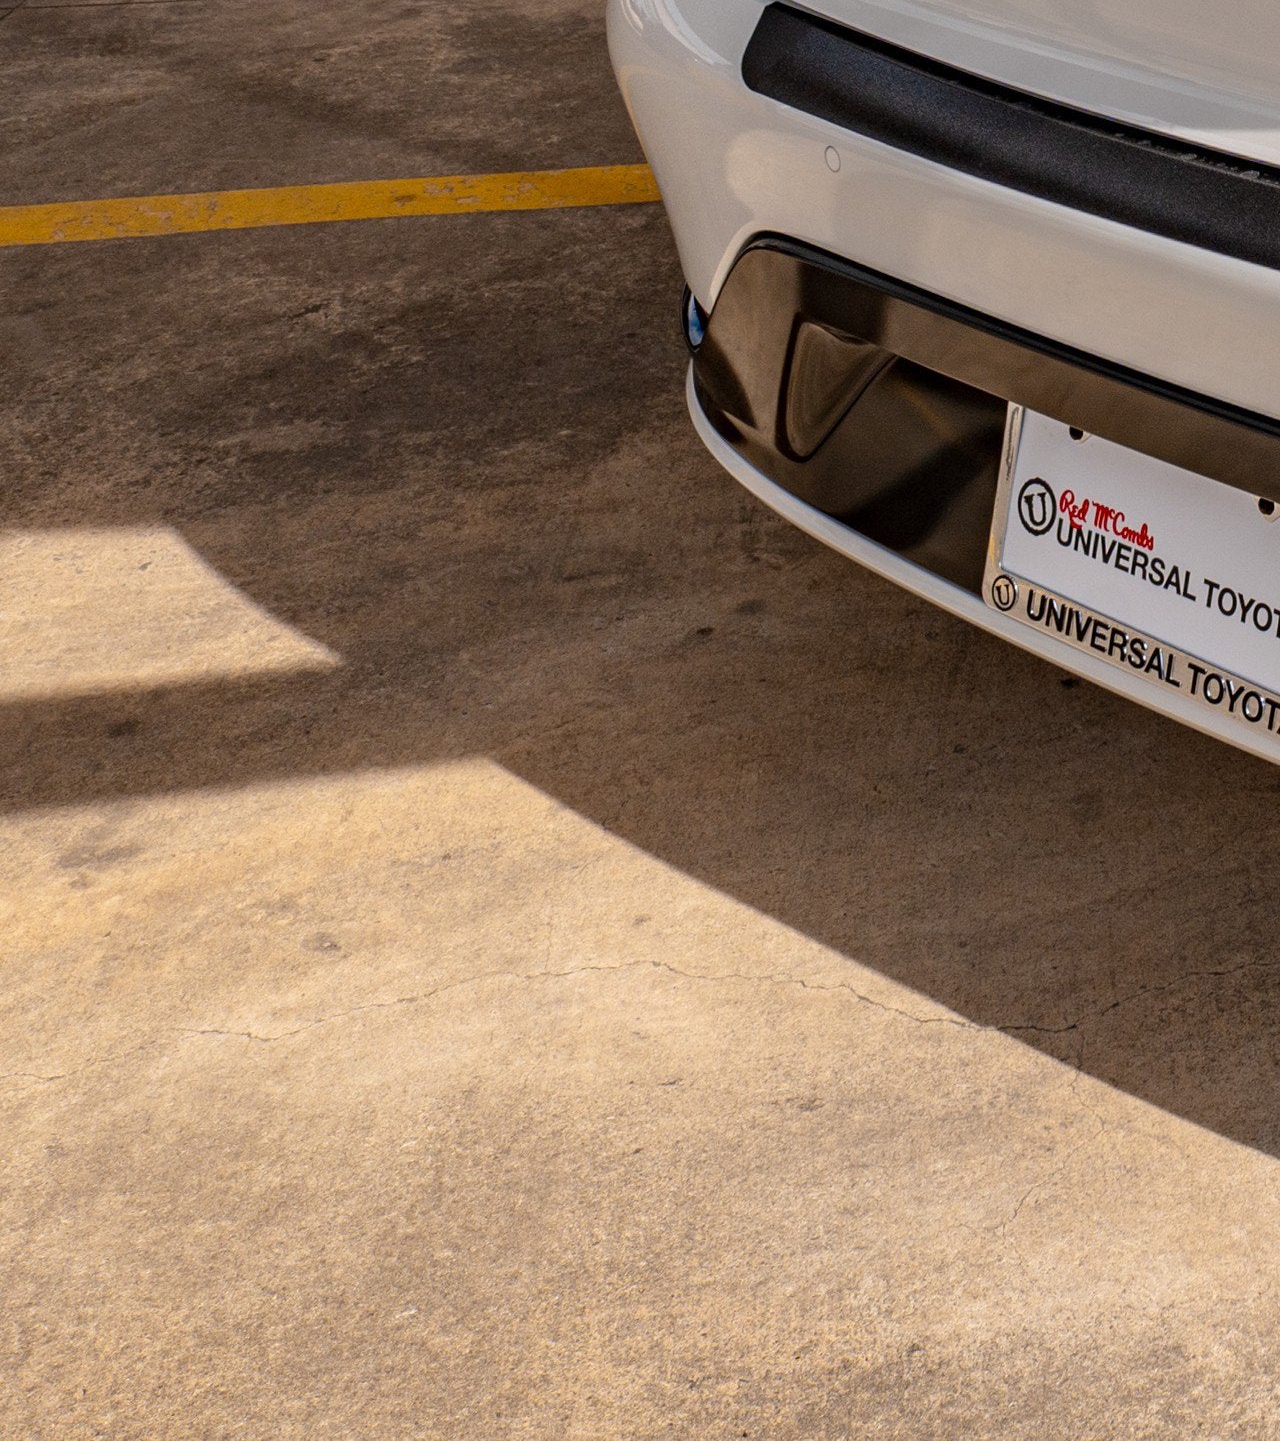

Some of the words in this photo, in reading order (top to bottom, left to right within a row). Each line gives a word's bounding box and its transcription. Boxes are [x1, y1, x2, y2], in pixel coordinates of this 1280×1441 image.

[1055, 517, 1197, 602] UNIVERSAL
[1059, 489, 1090, 529] Red
[1091, 500, 1155, 551] McCombs
[1026, 589, 1181, 688] UNIVERSAL
